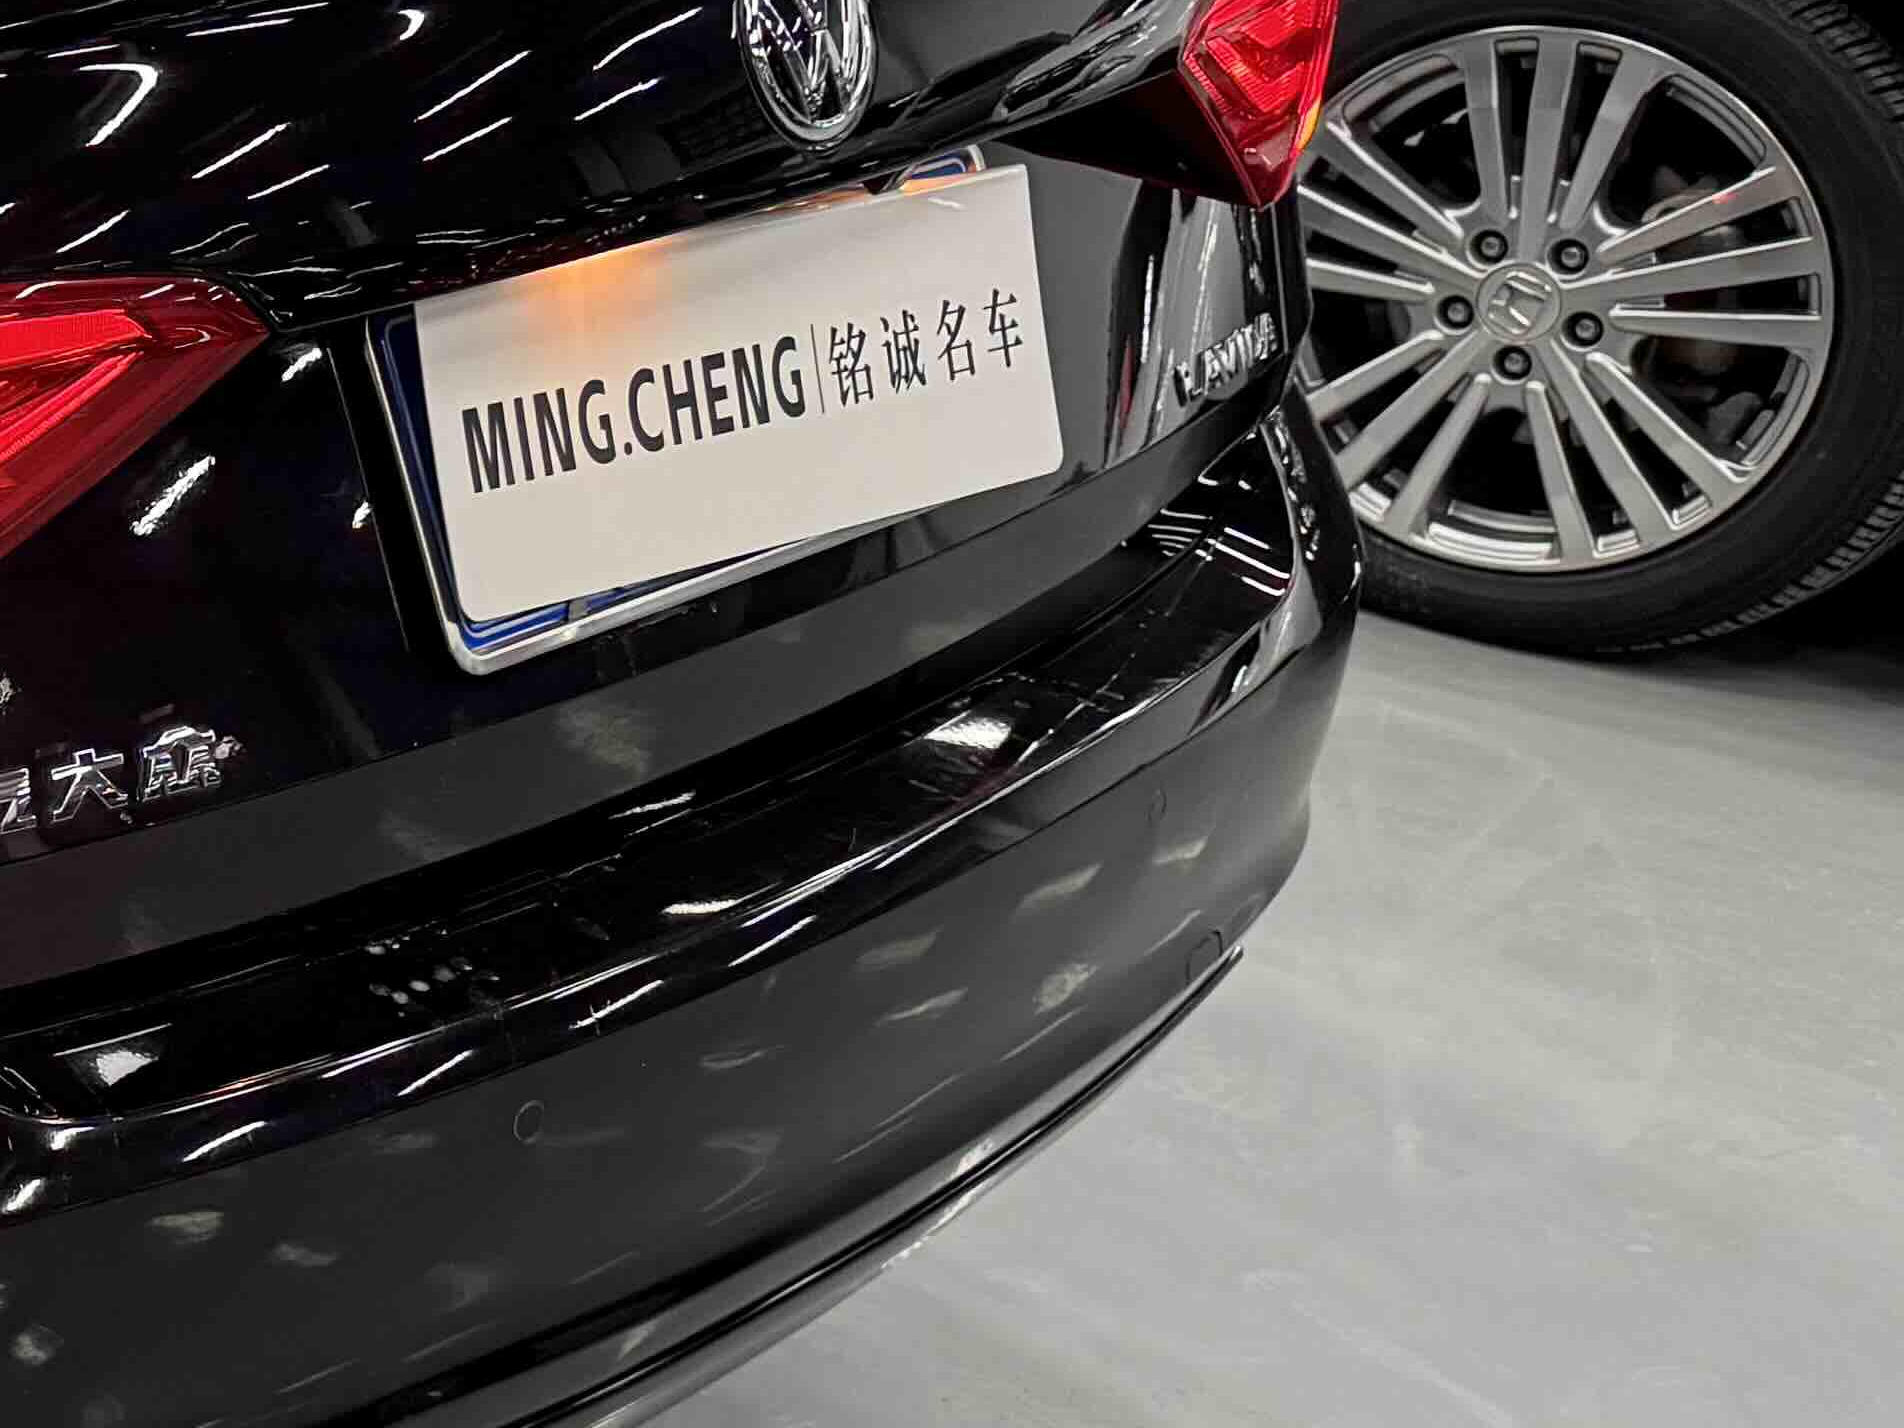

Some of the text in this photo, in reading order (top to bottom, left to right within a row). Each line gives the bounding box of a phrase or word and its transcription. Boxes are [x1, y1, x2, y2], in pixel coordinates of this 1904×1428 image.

[461, 287, 1024, 494] MING.CHENG 铭诚名车
